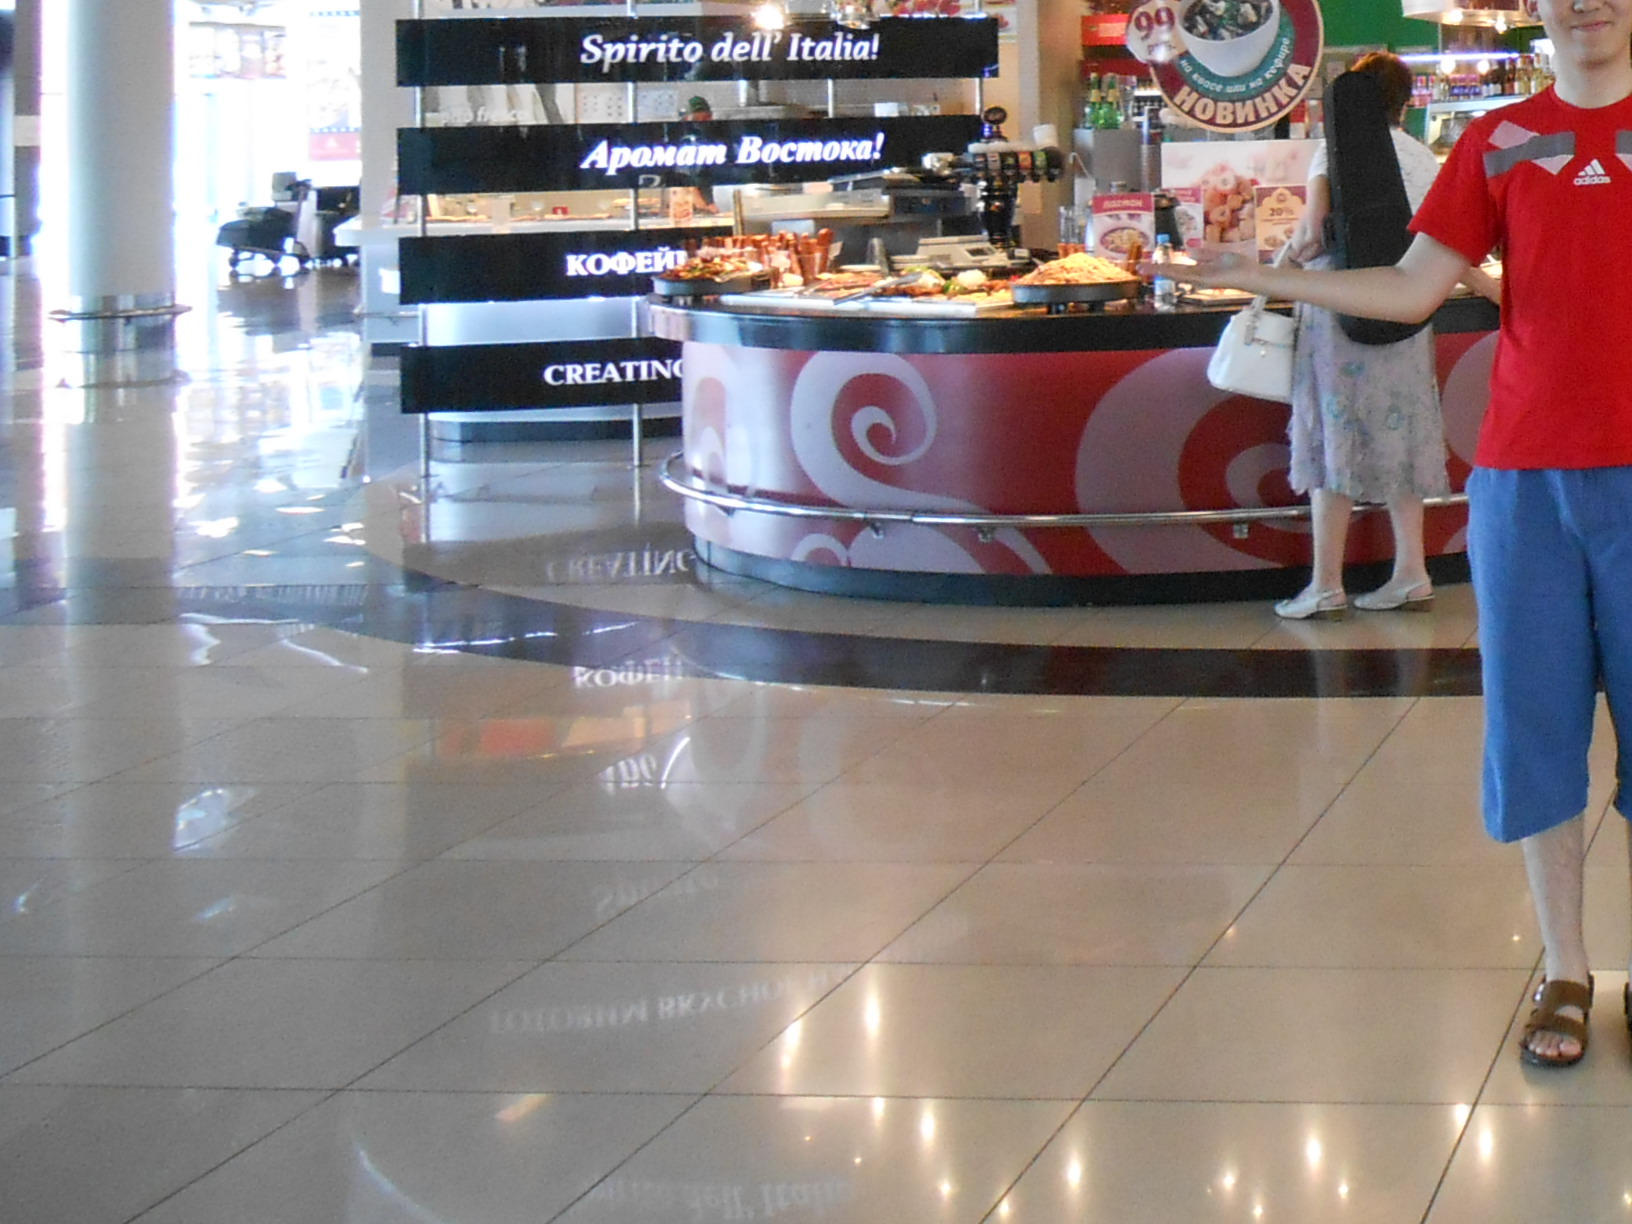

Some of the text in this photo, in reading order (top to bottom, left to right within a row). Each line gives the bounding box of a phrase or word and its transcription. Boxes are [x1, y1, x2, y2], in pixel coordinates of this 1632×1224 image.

[580, 34, 701, 71] Spirito
[789, 33, 880, 62] Italia!
[1173, 63, 1313, 125] НОВИНКА
[580, 132, 885, 176] Аромат Востока!
